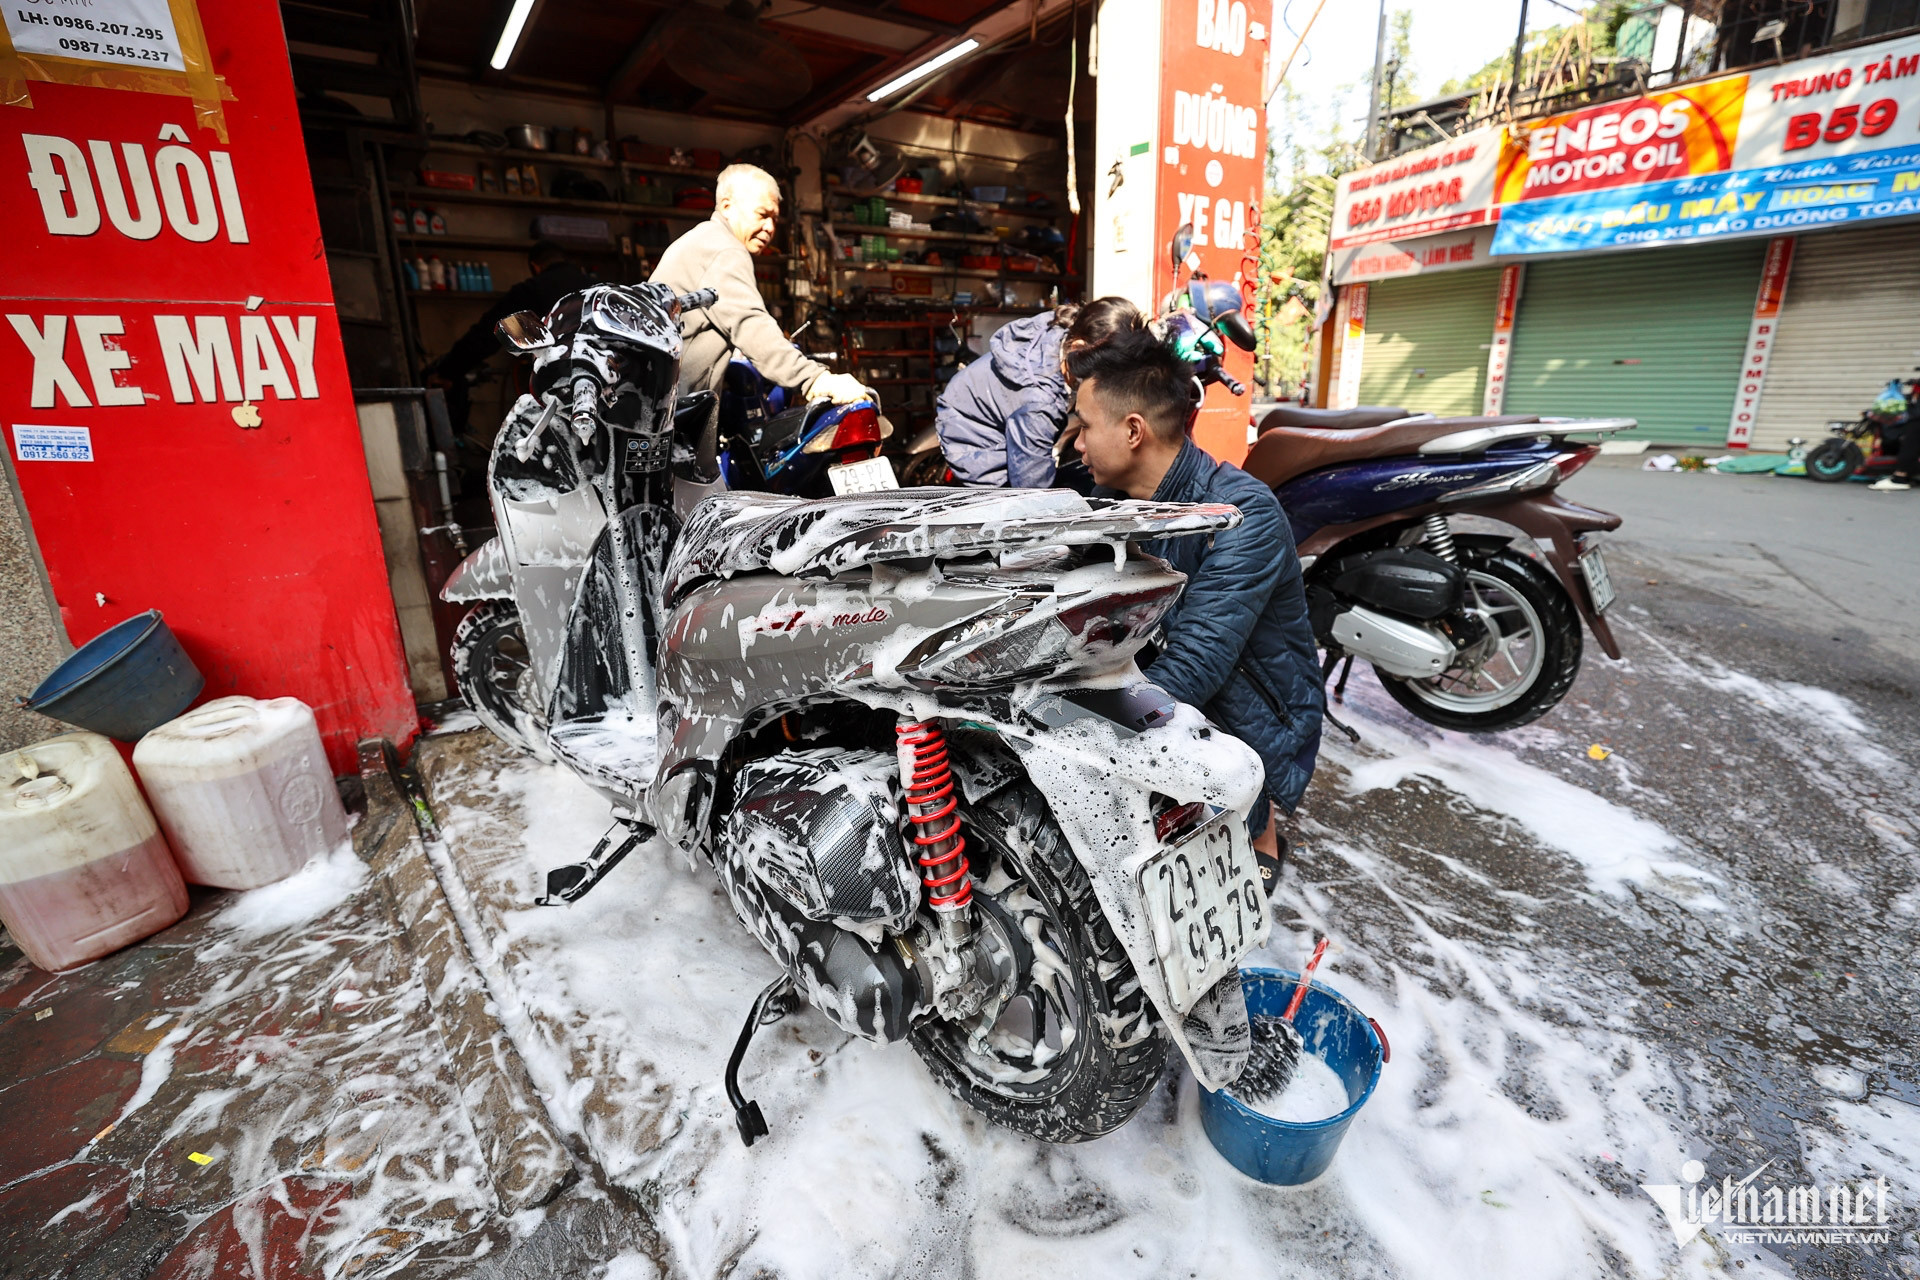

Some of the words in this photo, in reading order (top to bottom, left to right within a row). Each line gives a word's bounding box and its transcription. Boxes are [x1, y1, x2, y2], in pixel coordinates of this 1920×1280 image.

[17, 10, 49, 26] LH:
[53, 15, 164, 41] 0986.207.295
[58, 37, 169, 63] 0987.545.237
[1771, 68, 1854, 102] TRUNG
[1864, 54, 1920, 84] TÂM
[1527, 99, 1692, 161] ENEOS
[1783, 98, 1898, 152] B59
[22, 123, 250, 244] ĐUÔI
[1524, 151, 1627, 189] MOTOR
[1631, 141, 1683, 171] OIL
[1176, 192, 1210, 247] XE
[1213, 197, 1247, 250] GA
[1387, 176, 1464, 219] MOTOR
[1663, 224, 1693, 240] XE
[5, 314, 145, 408] XE
[153, 295, 320, 404] MÁY
[832, 607, 887, 626] mode
[1188, 878, 1263, 974] 95.79
